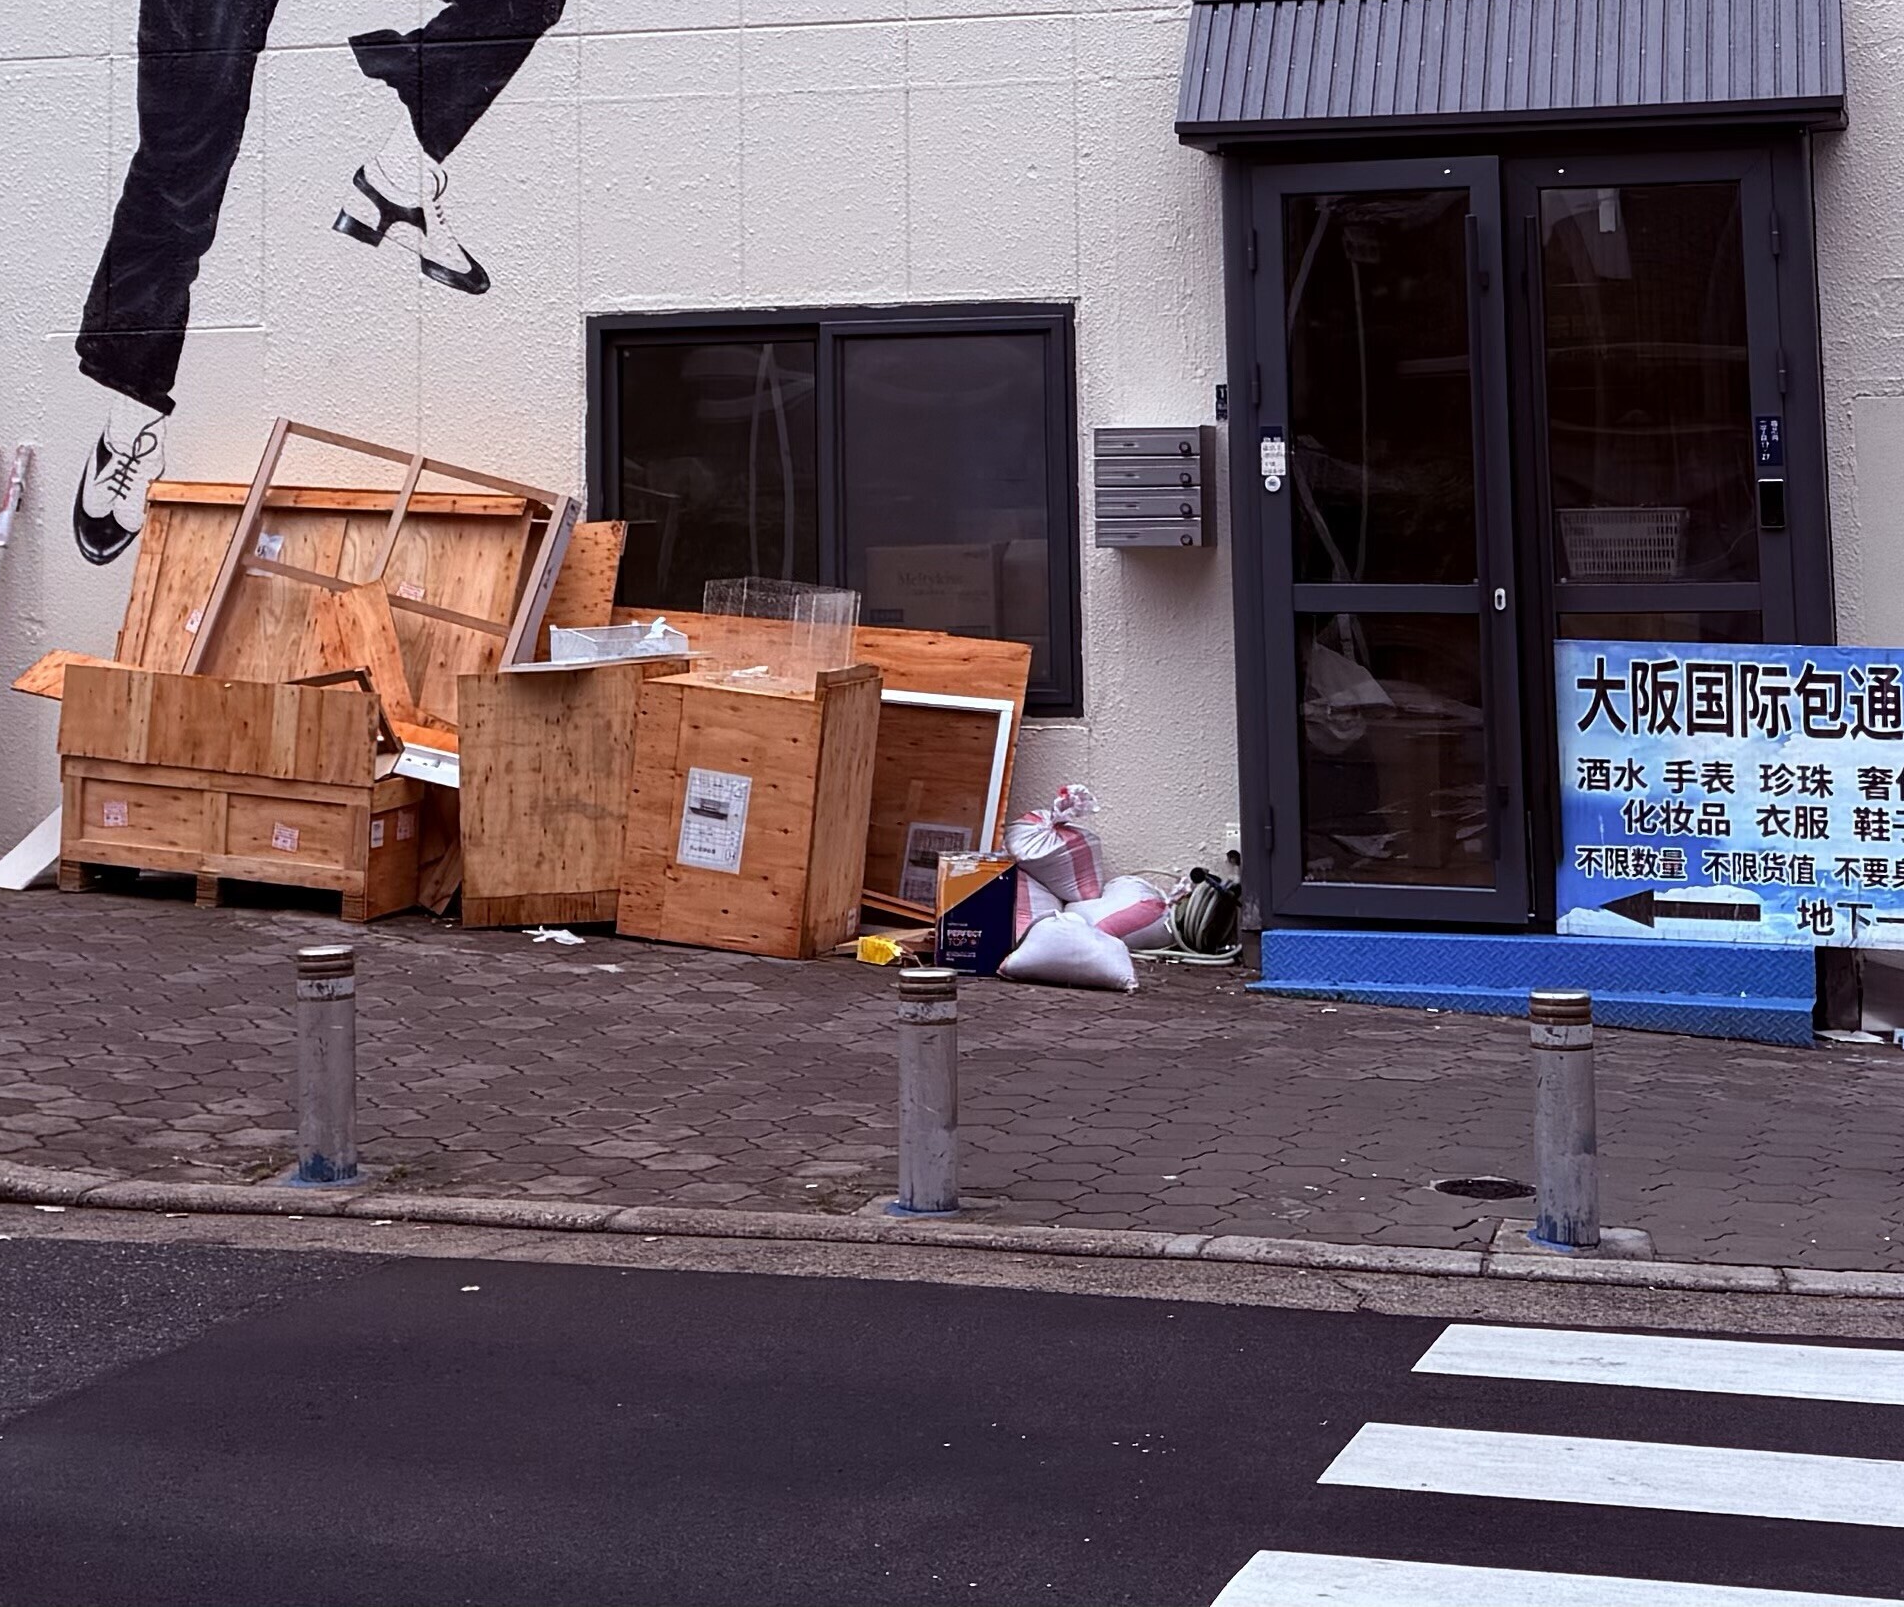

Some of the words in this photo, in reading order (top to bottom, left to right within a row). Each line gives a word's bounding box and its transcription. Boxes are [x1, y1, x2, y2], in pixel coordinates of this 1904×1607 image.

[1577, 757, 1649, 793] 酒水
[1663, 760, 1735, 795] 手表
[1759, 763, 1834, 799] 珍珠
[1623, 799, 1732, 838] 化妆品
[1755, 803, 1830, 841] 衣服
[1575, 846, 1688, 882] 不限数量
[1703, 851, 1817, 887] 不限货值
